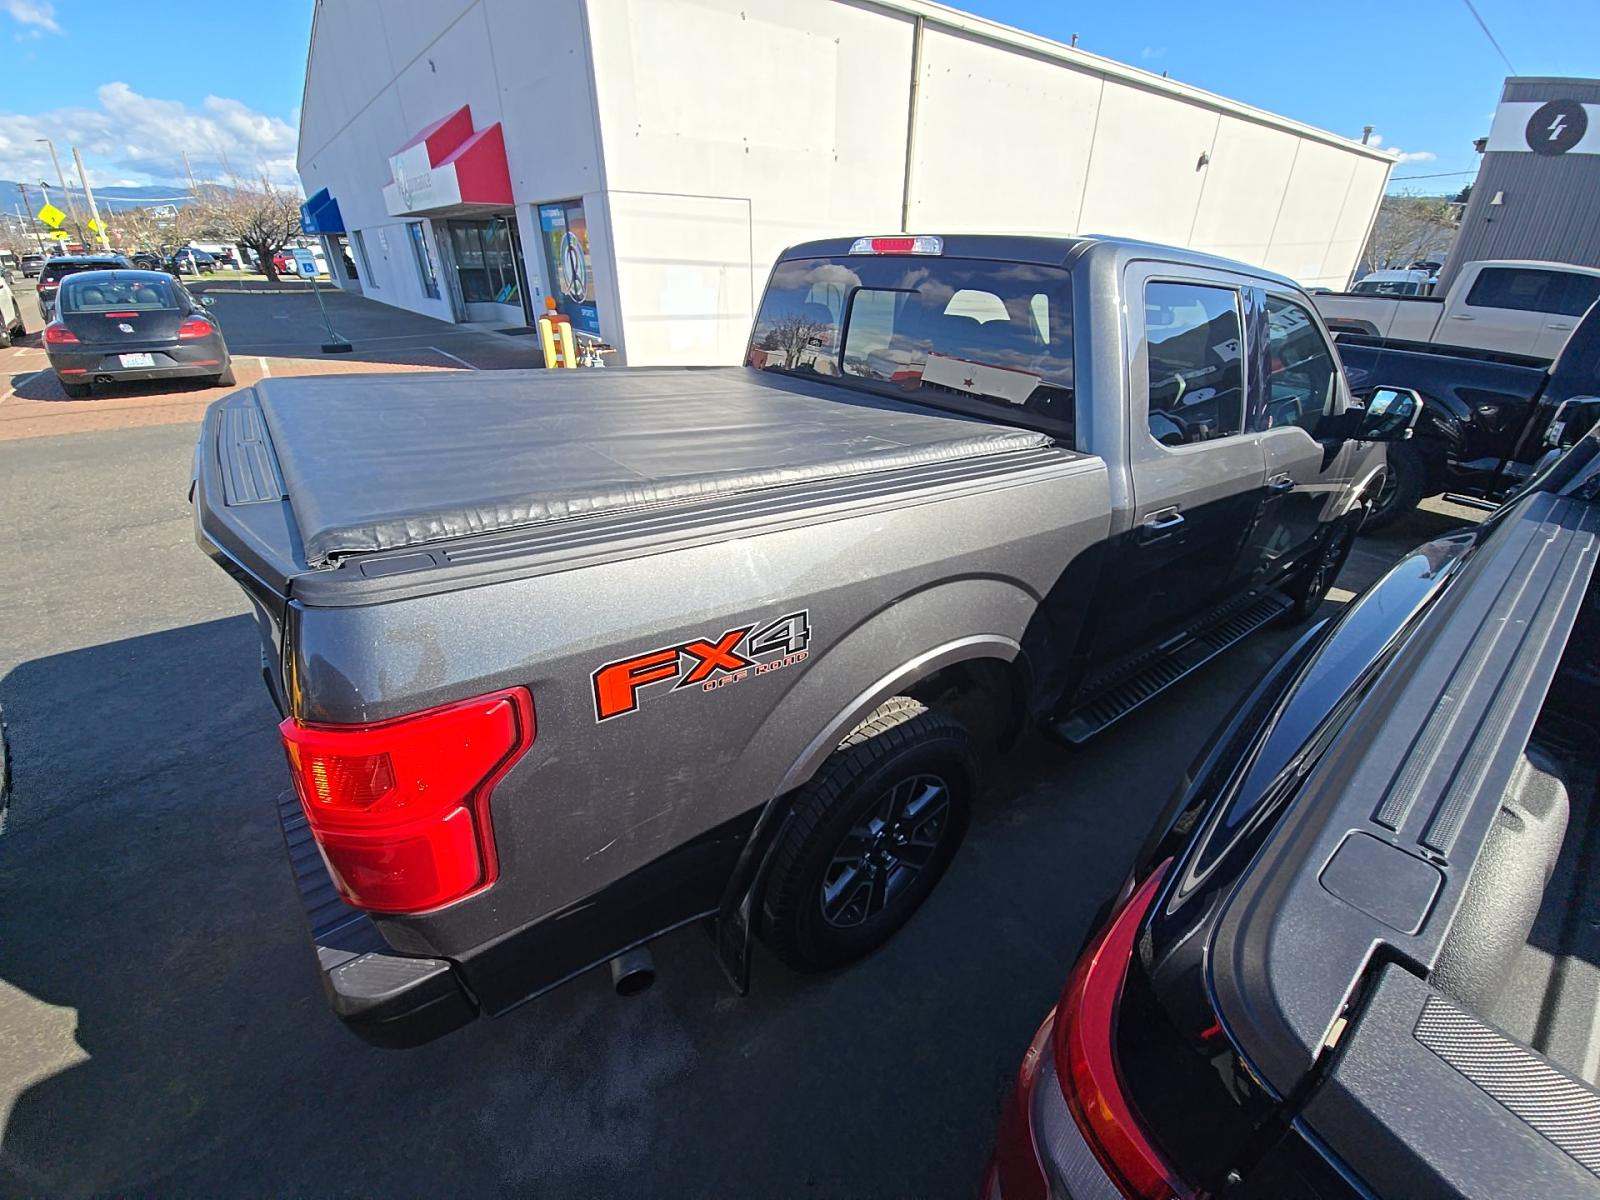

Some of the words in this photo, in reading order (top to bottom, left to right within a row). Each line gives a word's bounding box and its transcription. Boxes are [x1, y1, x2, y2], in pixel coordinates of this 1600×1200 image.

[590, 608, 811, 724] FX4
[703, 670, 748, 692] OFF
[754, 652, 809, 676] ROAD
